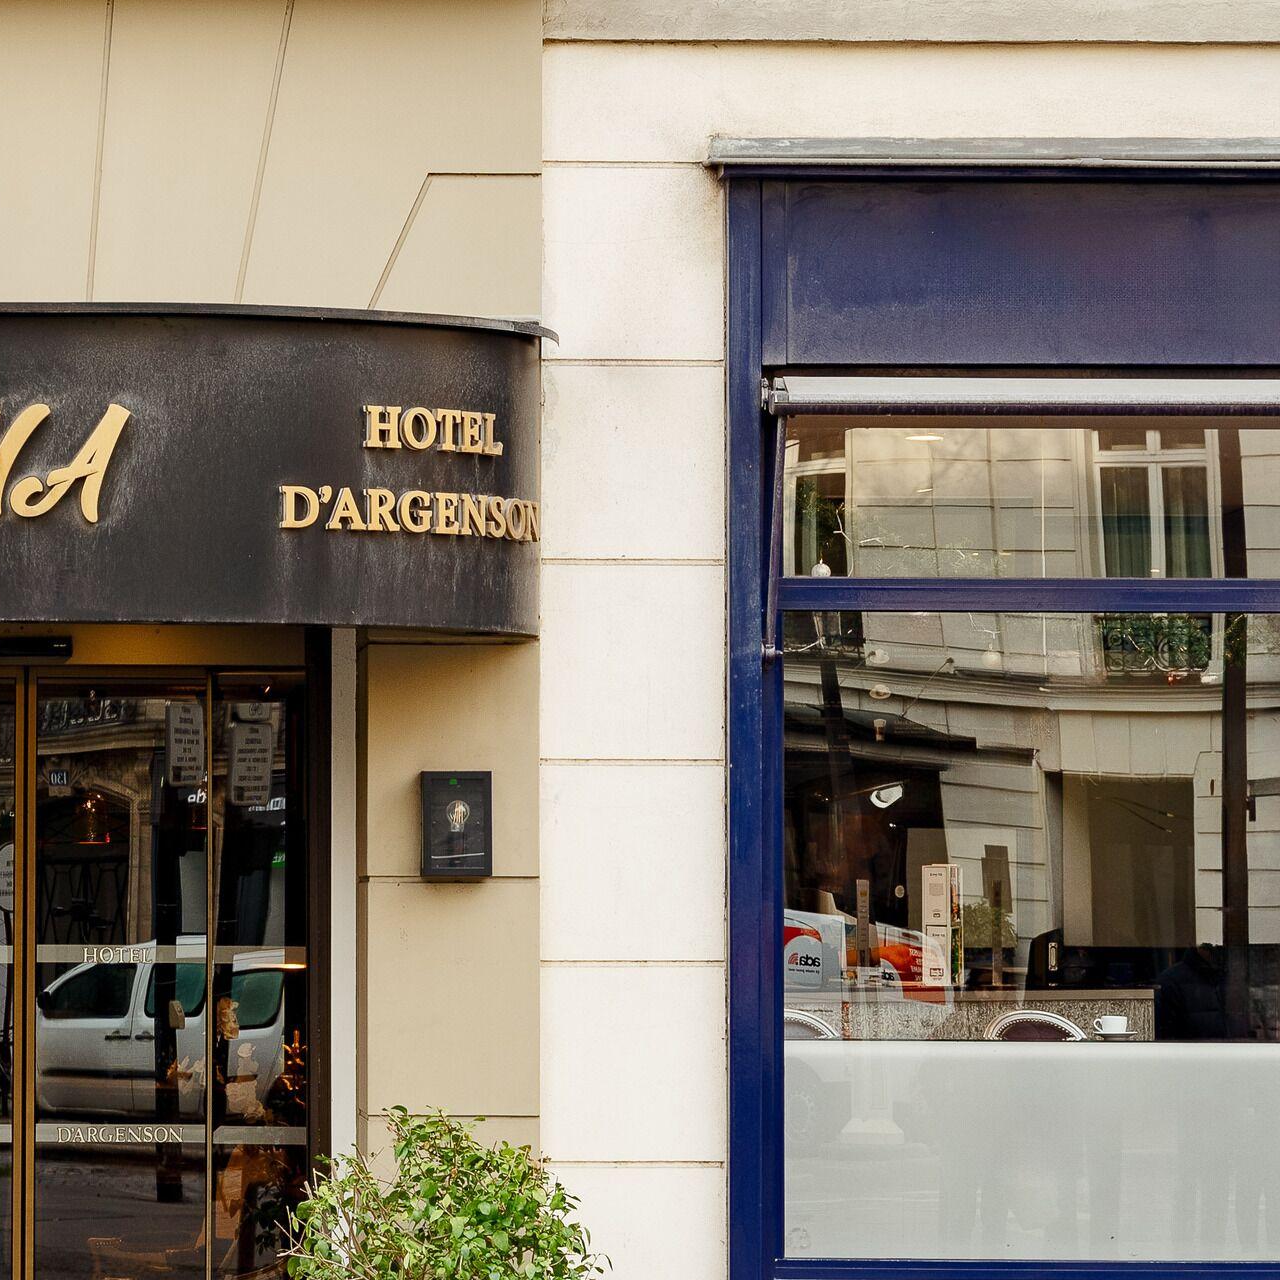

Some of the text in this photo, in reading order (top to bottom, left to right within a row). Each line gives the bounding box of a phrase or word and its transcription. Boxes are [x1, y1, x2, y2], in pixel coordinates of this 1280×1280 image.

[362, 404, 504, 457] HOTEL
[278, 484, 541, 543] D'ARGENSON
[82, 946, 154, 964] HOTEL
[56, 1125, 185, 1144] D'ARGENSON
